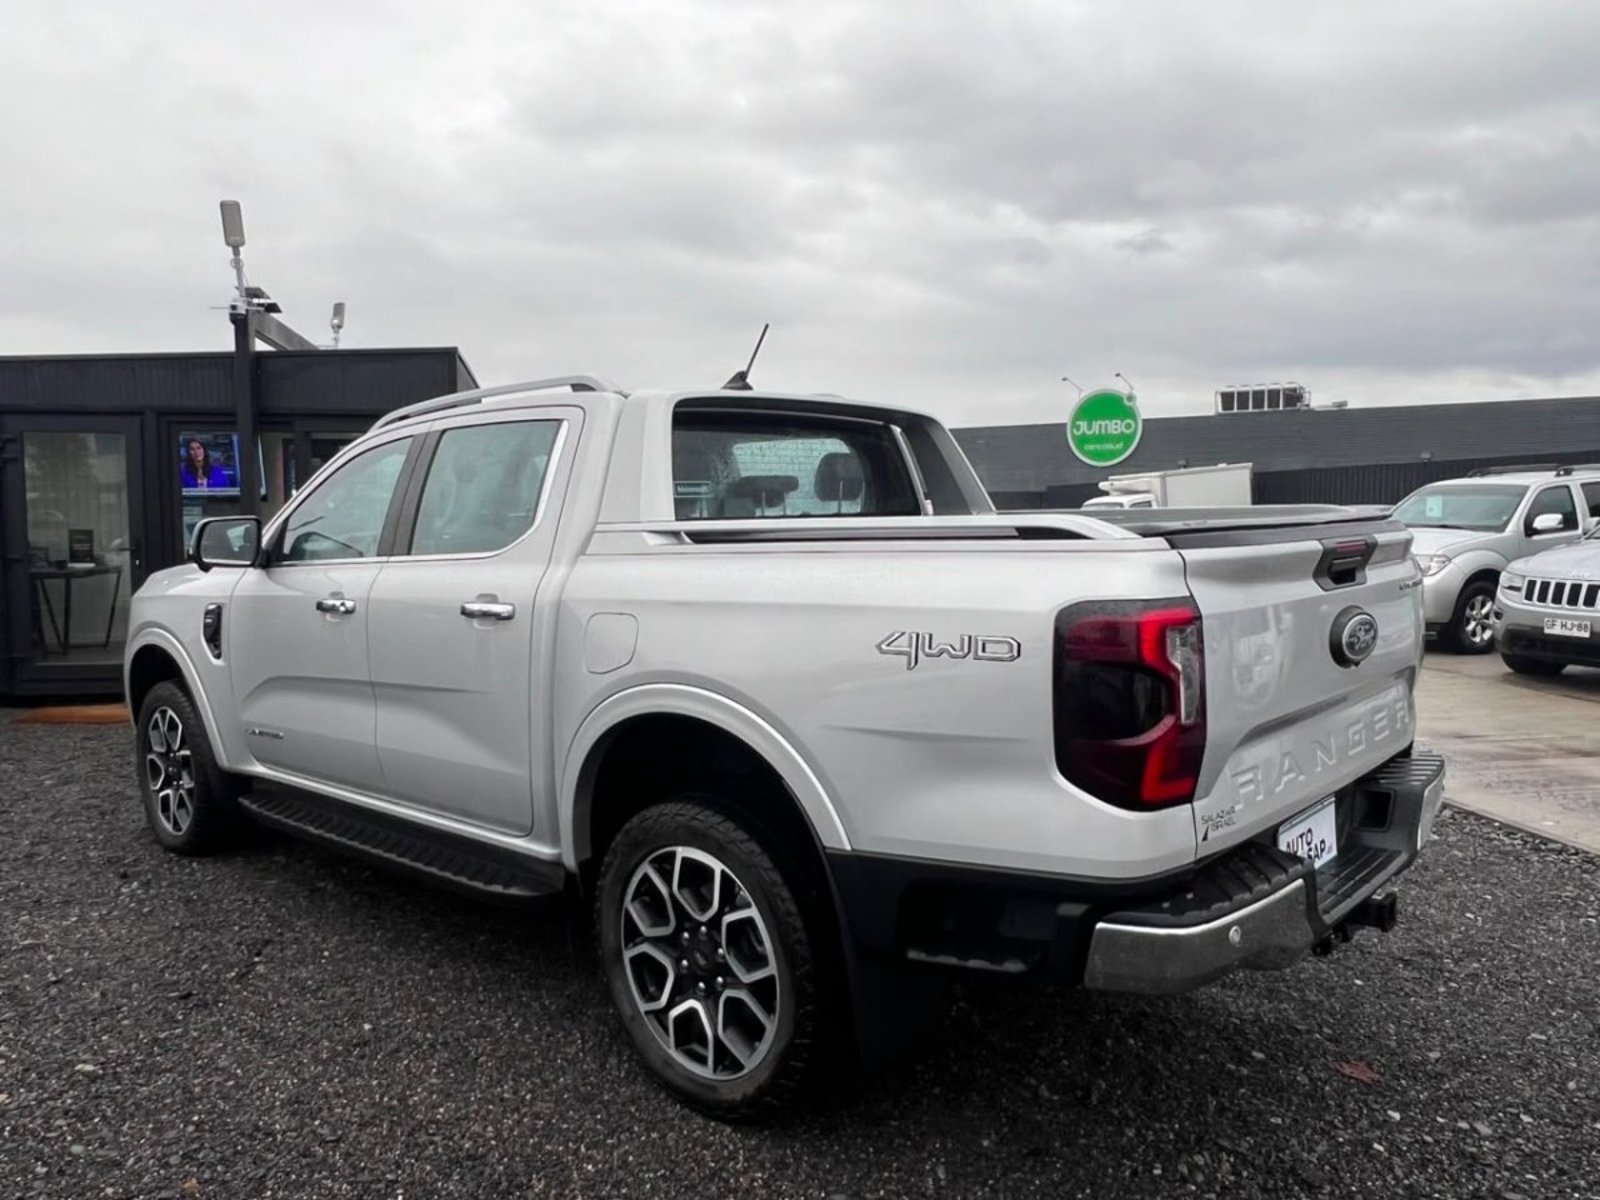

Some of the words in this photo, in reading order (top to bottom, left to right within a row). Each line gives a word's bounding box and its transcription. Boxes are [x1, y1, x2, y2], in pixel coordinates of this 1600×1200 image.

[1073, 419, 1135, 436] JUMBO
[875, 631, 1021, 671] 4WD
[1230, 699, 1410, 812] RANGER
[1286, 827, 1313, 854] AUTO
